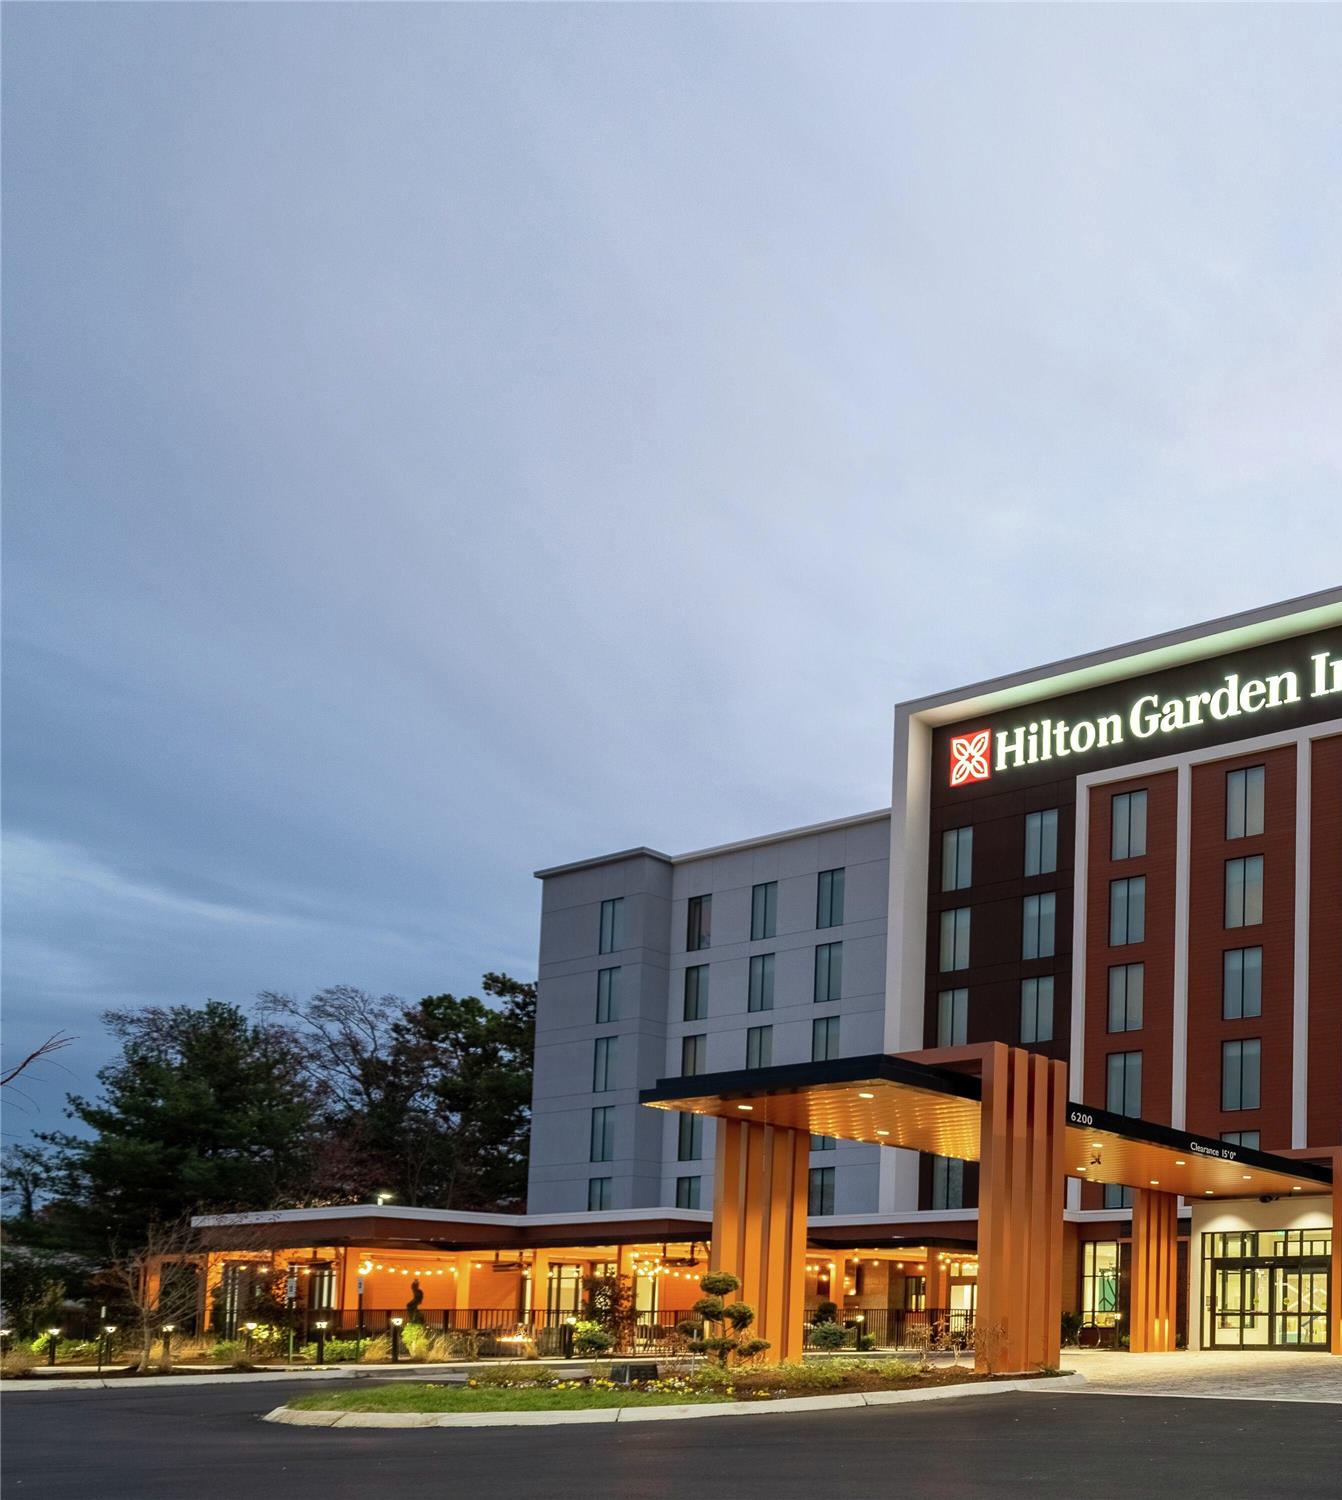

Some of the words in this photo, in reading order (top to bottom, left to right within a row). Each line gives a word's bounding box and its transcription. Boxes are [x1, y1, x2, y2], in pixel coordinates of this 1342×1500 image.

[995, 714, 1124, 772] Hilton
[1129, 671, 1301, 738] Garden
[1070, 1111, 1093, 1125] 6200
[1190, 1141, 1220, 1157] Clearance
